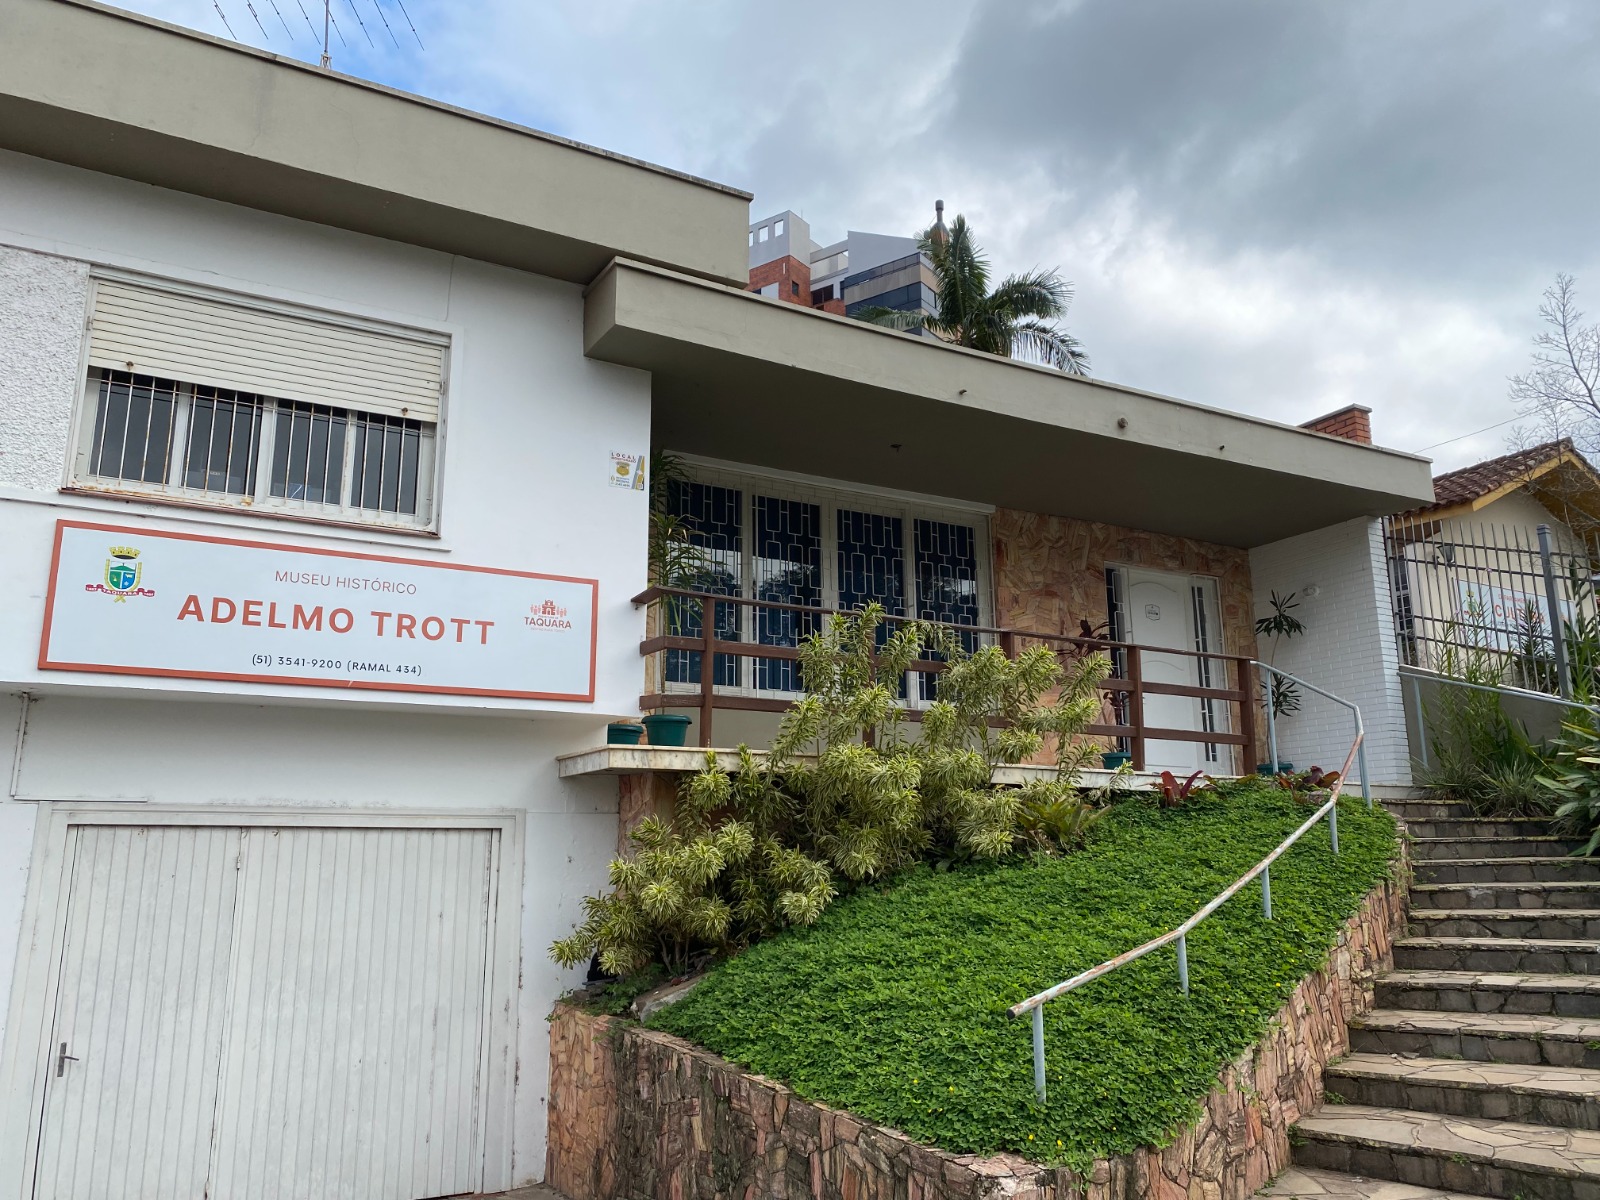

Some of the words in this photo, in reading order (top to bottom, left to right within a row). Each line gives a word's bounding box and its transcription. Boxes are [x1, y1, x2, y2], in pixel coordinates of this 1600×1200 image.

[611, 452, 635, 460] LOCAL
[275, 570, 331, 586] MUSEU
[336, 576, 418, 595] HISTÓRICO
[103, 588, 137, 596] TAQUARA
[176, 594, 354, 634] ADELMO
[370, 610, 495, 645] TROTT
[524, 616, 572, 629] TAQUARA
[251, 653, 273, 667] (51)
[278, 656, 342, 669] 3541-9200
[347, 659, 392, 673] (RAMAL
[396, 663, 422, 676] 434)
